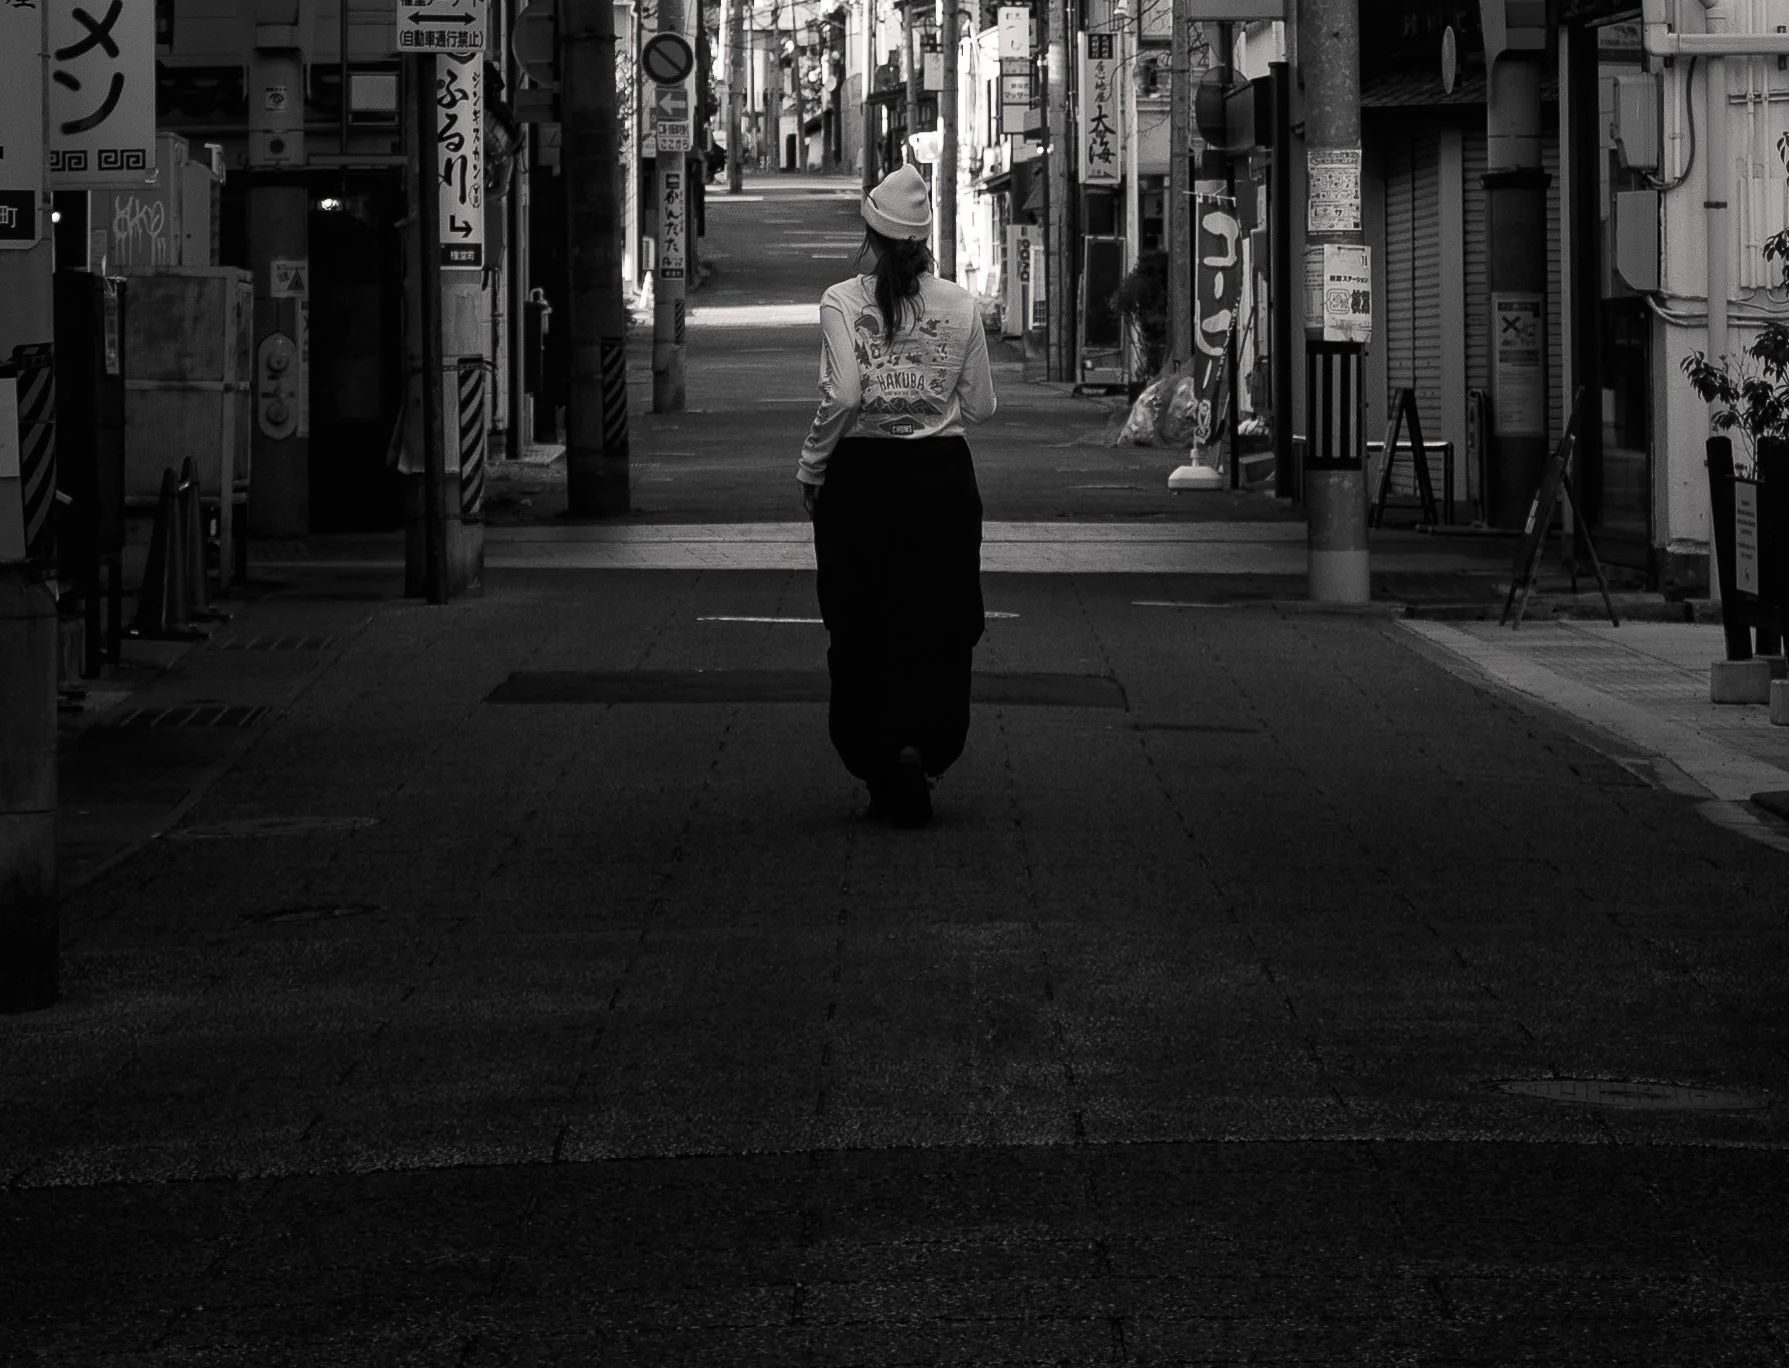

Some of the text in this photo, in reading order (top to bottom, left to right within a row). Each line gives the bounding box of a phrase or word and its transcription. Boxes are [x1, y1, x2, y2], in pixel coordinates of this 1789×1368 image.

[399, 30, 484, 48] (自動車通行禁止)
[1087, 103, 1116, 165] 大海
[877, 372, 925, 391] HAKUBA
